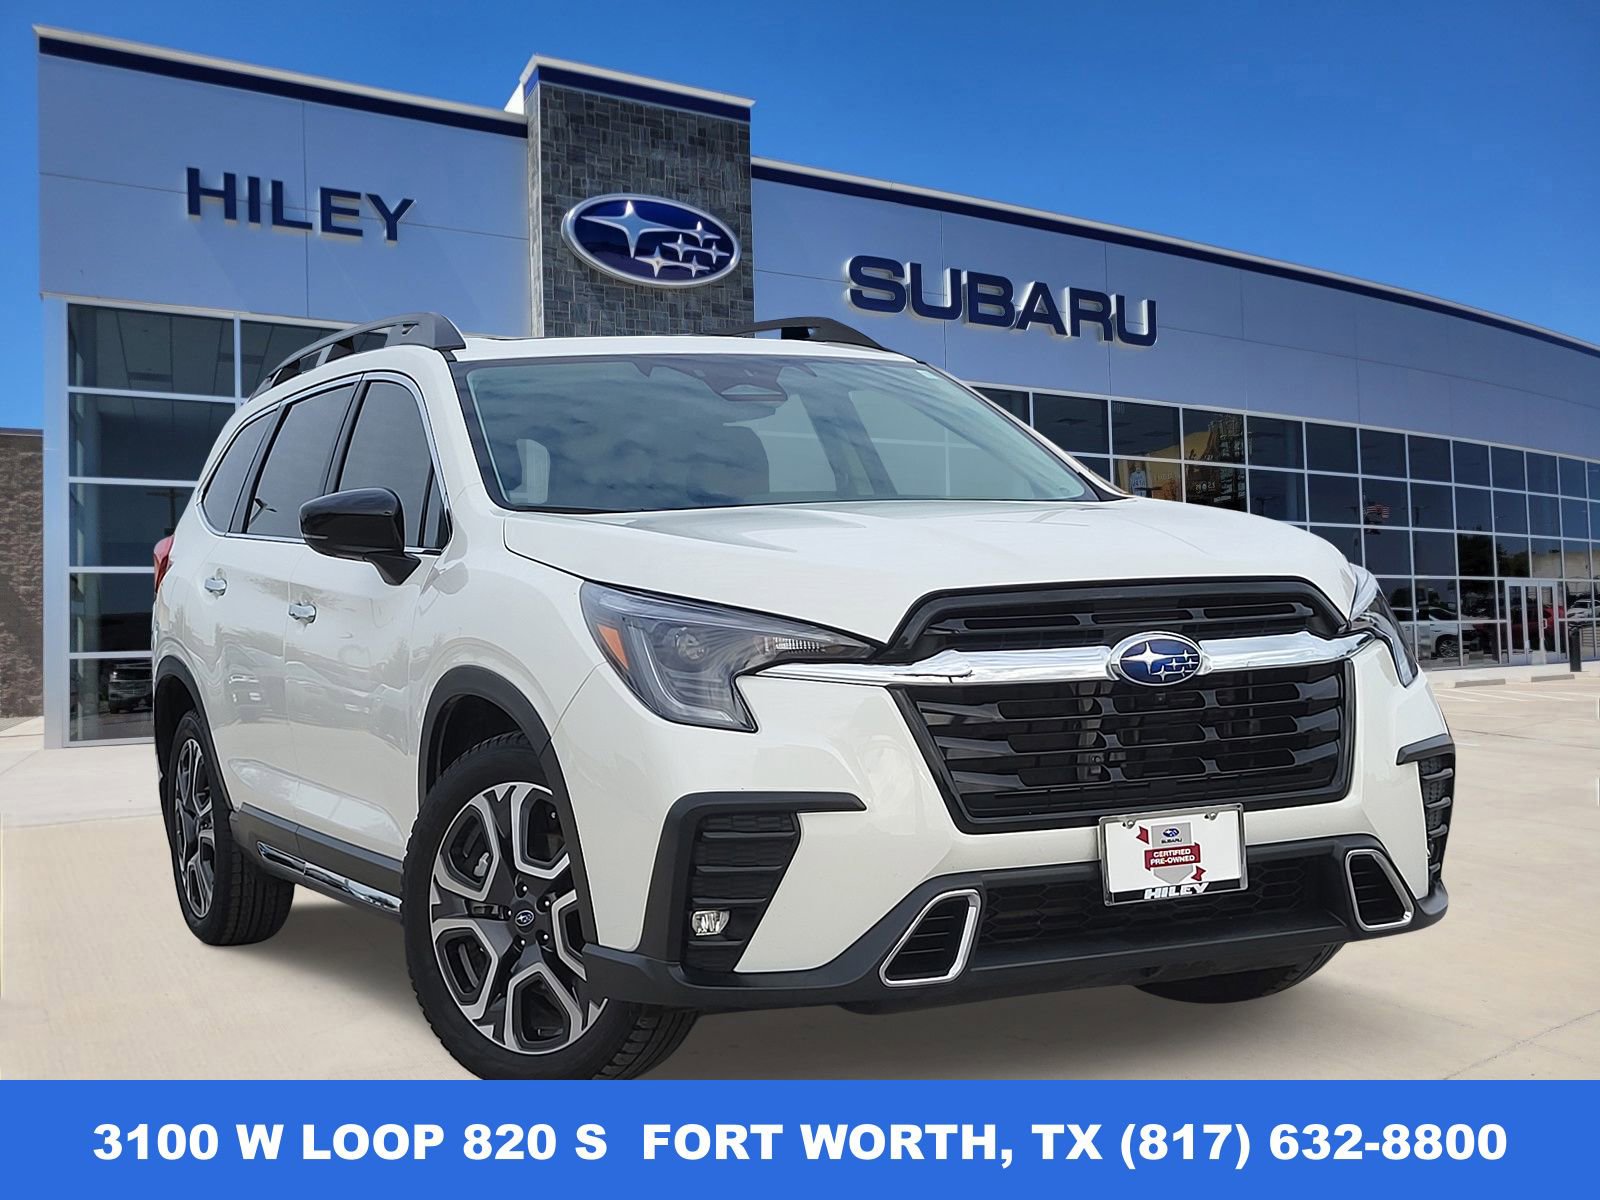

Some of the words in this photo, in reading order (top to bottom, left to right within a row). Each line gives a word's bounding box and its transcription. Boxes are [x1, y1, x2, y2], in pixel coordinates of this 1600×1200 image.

[186, 167, 416, 242] HILEY
[847, 254, 1158, 348] SUBARU
[1150, 855, 1195, 865] PRE-OWNED
[1153, 848, 1191, 857] CERTIFIED
[1144, 882, 1209, 899] HILEY
